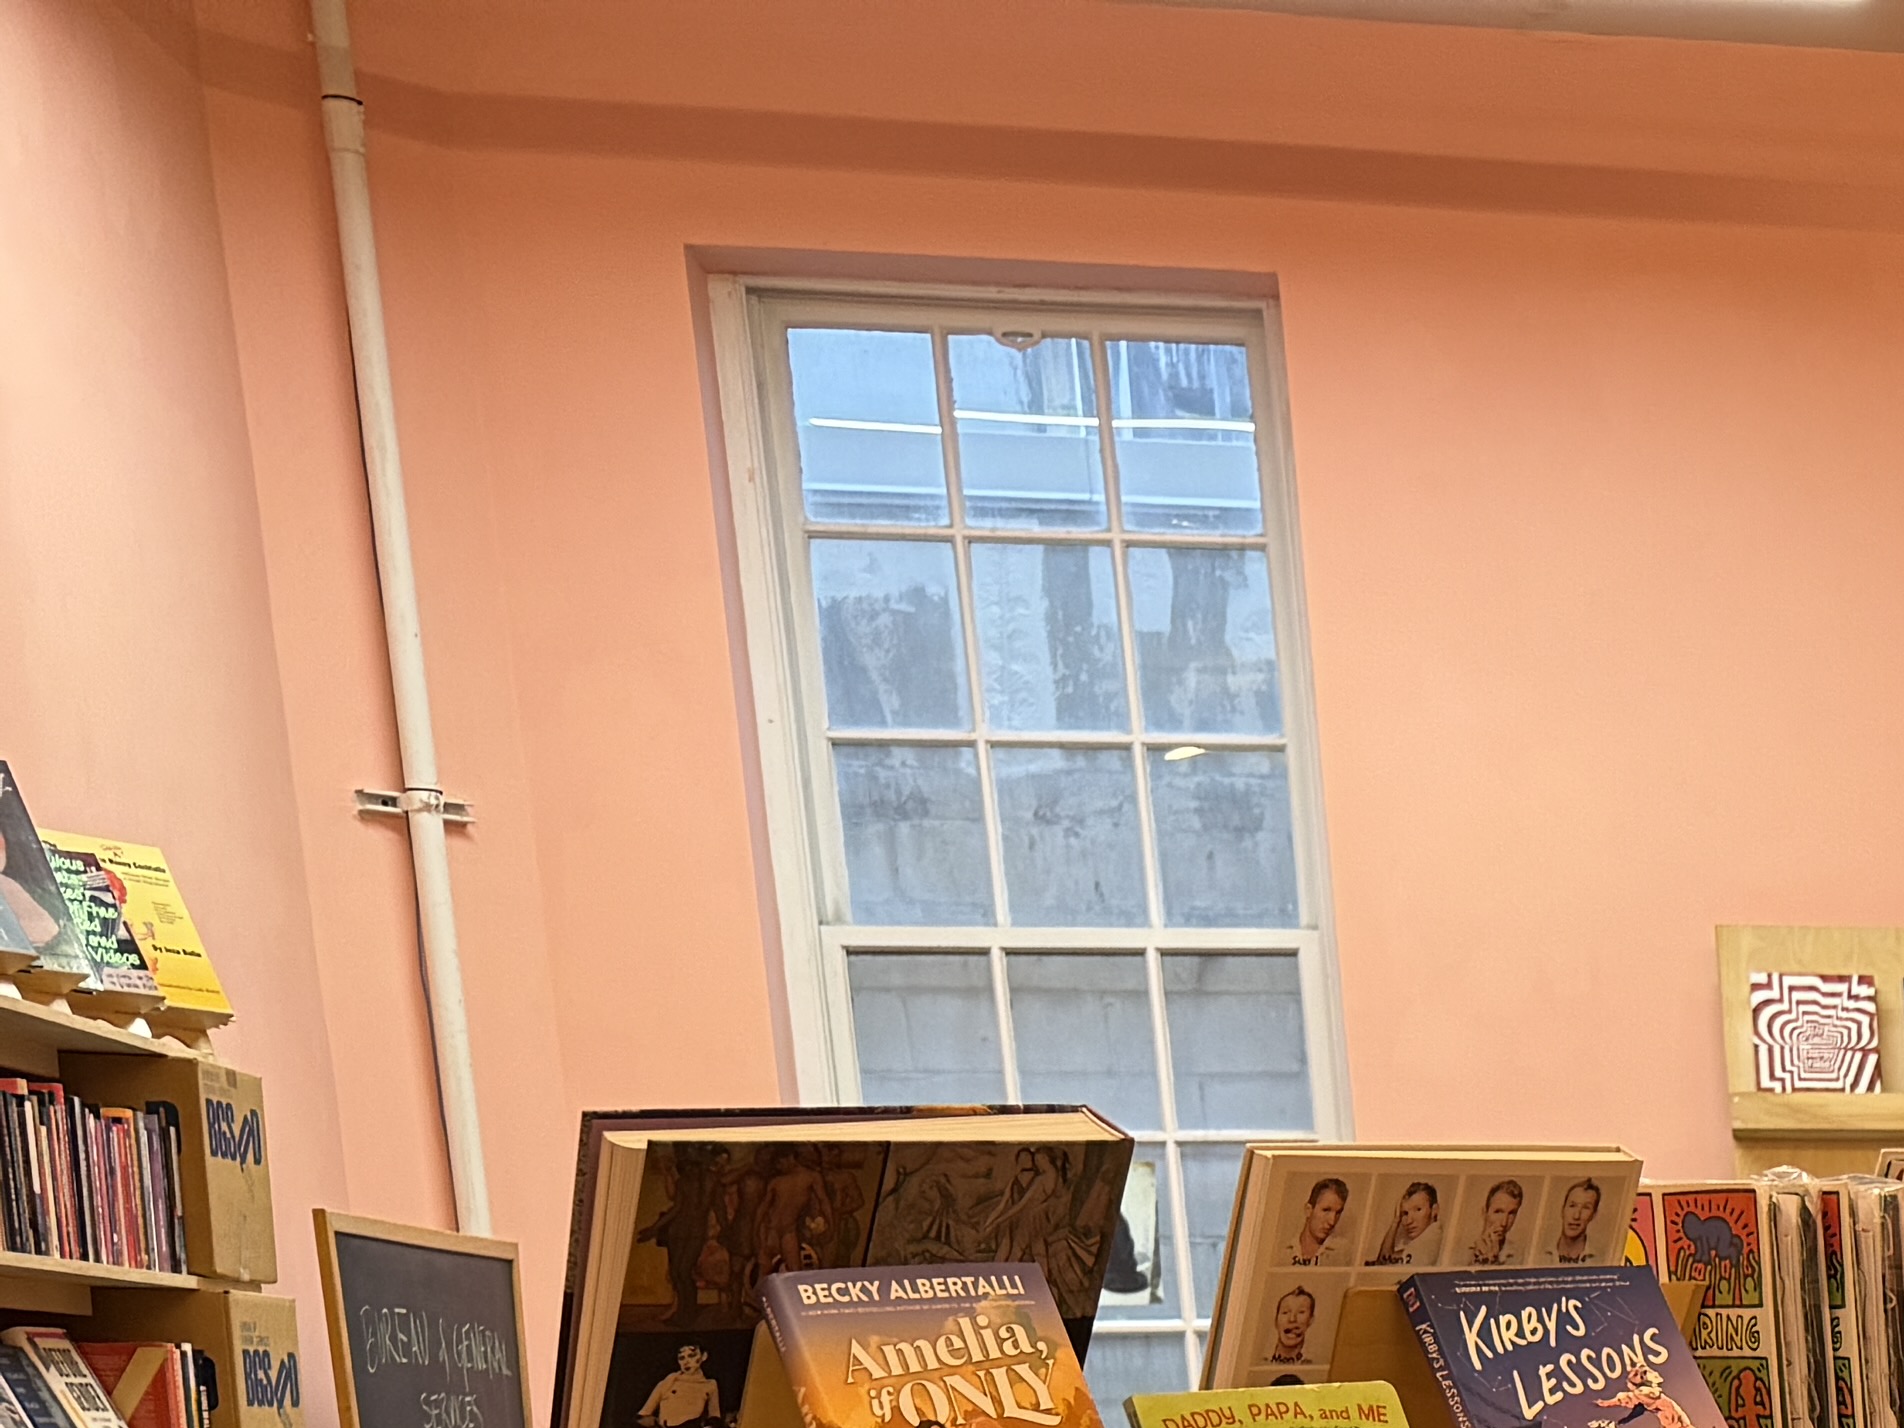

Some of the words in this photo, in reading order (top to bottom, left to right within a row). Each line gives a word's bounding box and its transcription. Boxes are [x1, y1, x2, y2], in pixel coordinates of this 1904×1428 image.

[798, 1280, 881, 1307] BECKY
[889, 1274, 1025, 1301] ALBERTALLI
[845, 1315, 1048, 1385] Amelia,
[1460, 1296, 1587, 1371] KIRBY'S
[869, 1384, 895, 1423] if
[898, 1358, 1063, 1428] ONLY
[1513, 1327, 1669, 1421] LESSONS
[1248, 1402, 1314, 1427] PAPA,
[1319, 1404, 1349, 1425] and
[1355, 1404, 1389, 1424] ME
